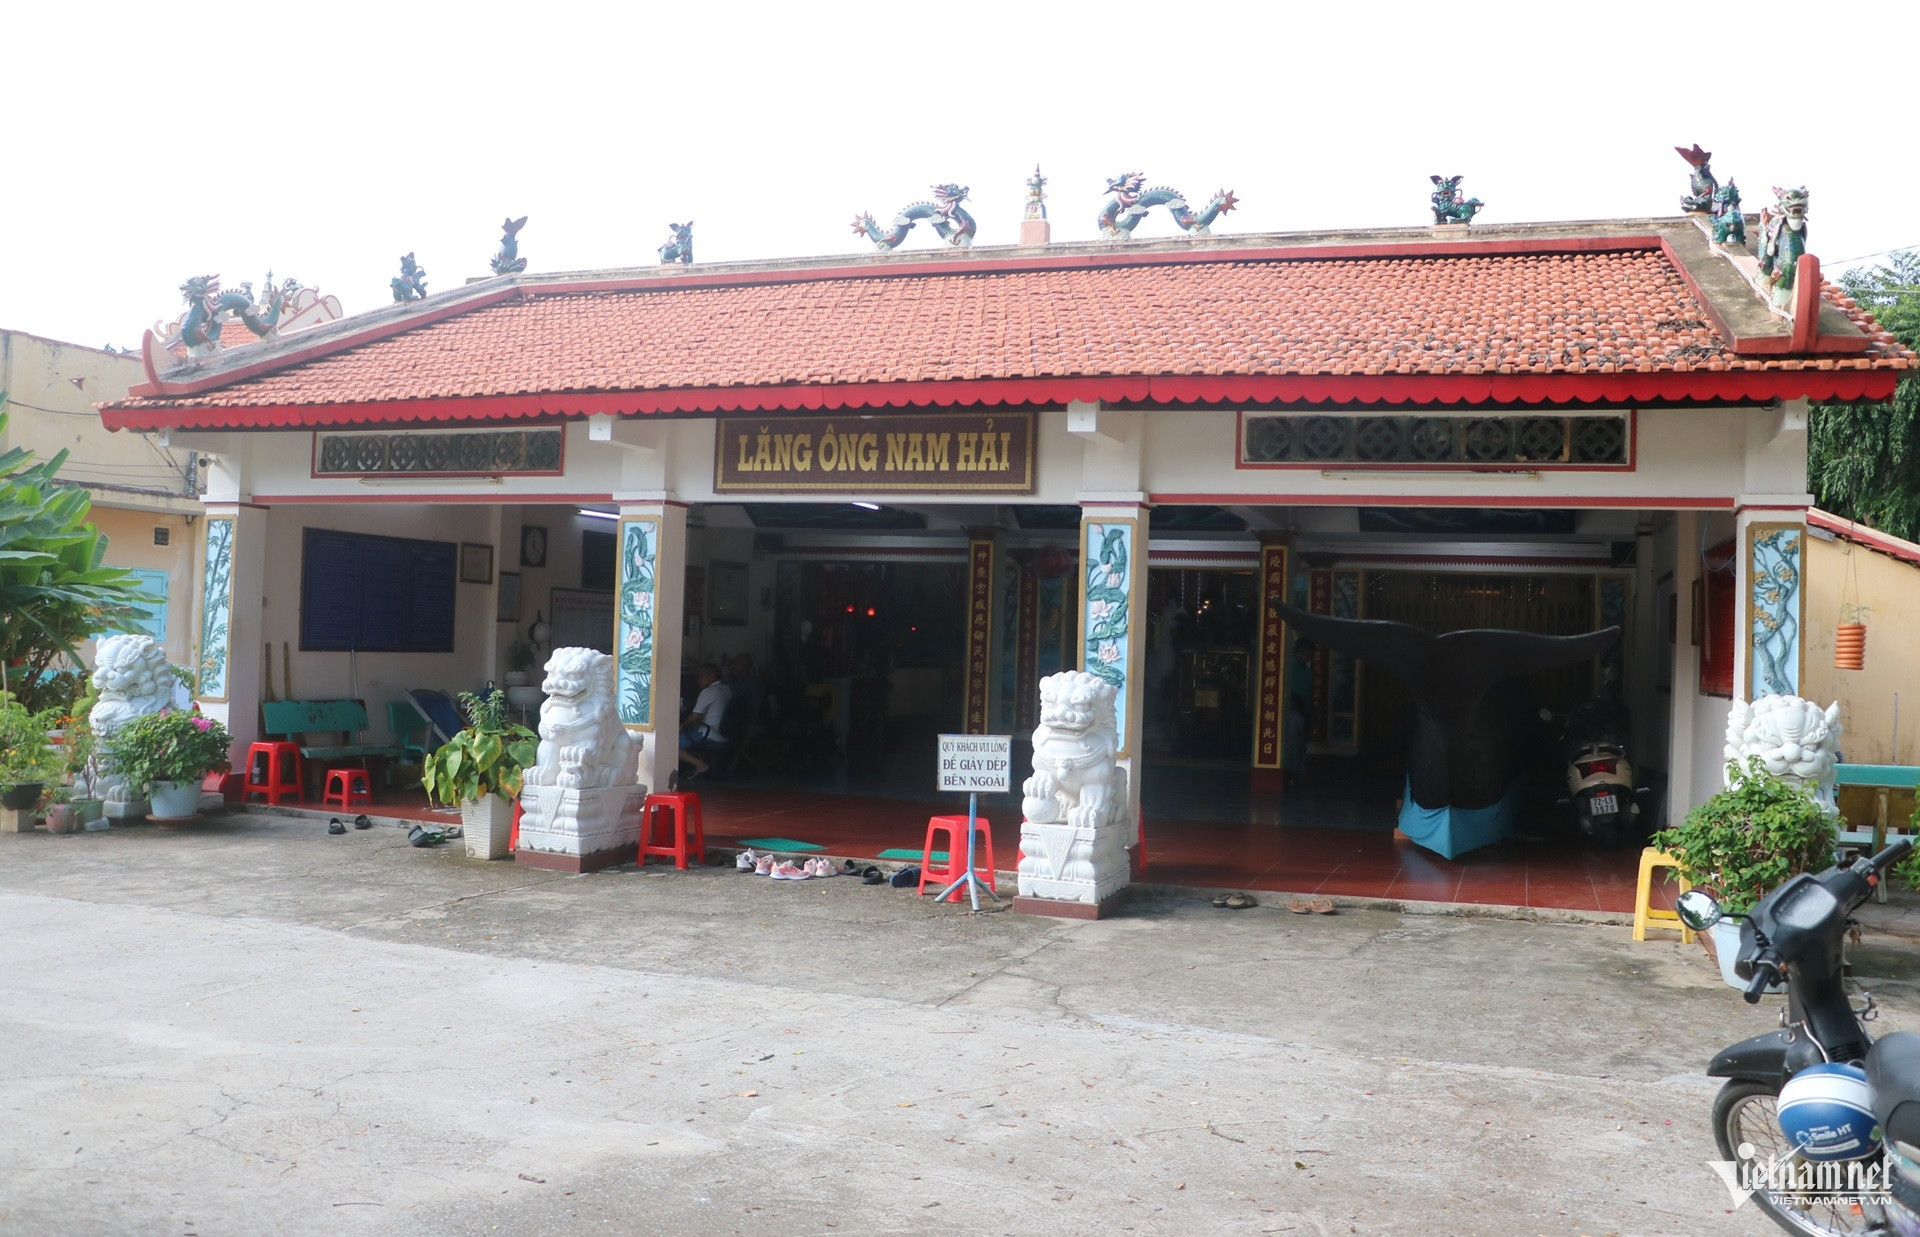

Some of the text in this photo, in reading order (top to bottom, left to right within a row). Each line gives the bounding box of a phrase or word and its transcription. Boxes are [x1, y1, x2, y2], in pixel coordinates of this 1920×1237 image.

[737, 418, 1011, 472] LĂNG ÔNG NAM HẢI
[942, 740, 1008, 753] QUÝ KHÁCH VUI LÒNG
[943, 754, 1007, 771] ĐỂ GIÀY DÉP
[944, 773, 1005, 787] BÊN NGOÀI
[1811, 1130, 1838, 1141] Smile
[1837, 1123, 1852, 1136] HT
